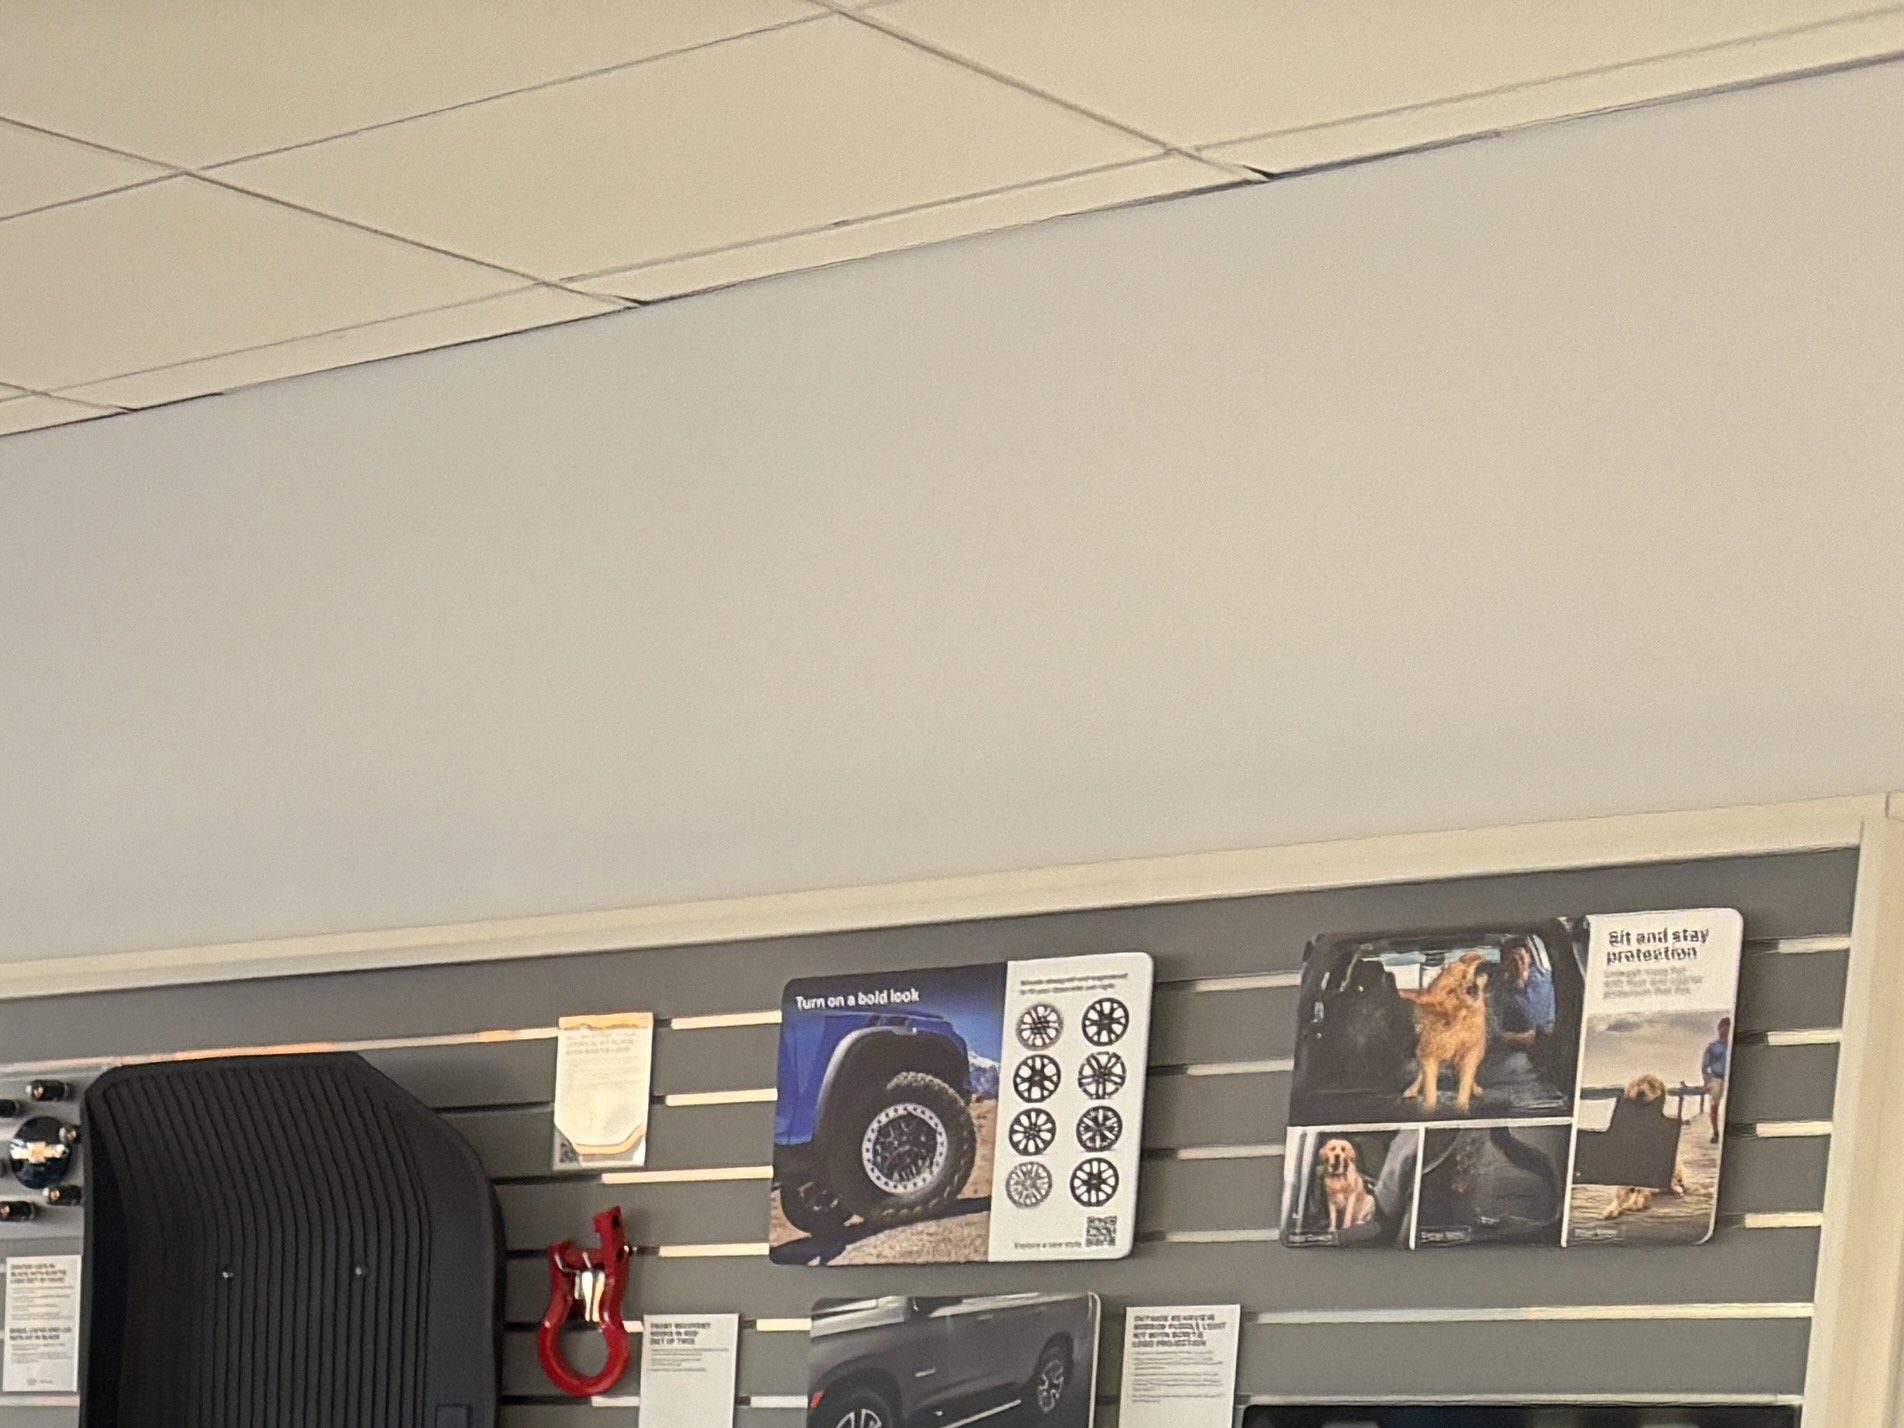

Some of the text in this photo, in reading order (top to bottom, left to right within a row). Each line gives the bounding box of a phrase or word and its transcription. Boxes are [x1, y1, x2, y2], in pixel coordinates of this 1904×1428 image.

[1636, 927, 1668, 945] and
[1672, 928, 1709, 944] stay
[1606, 946, 1697, 966] protection
[795, 987, 920, 1011] Turn on a bold look
